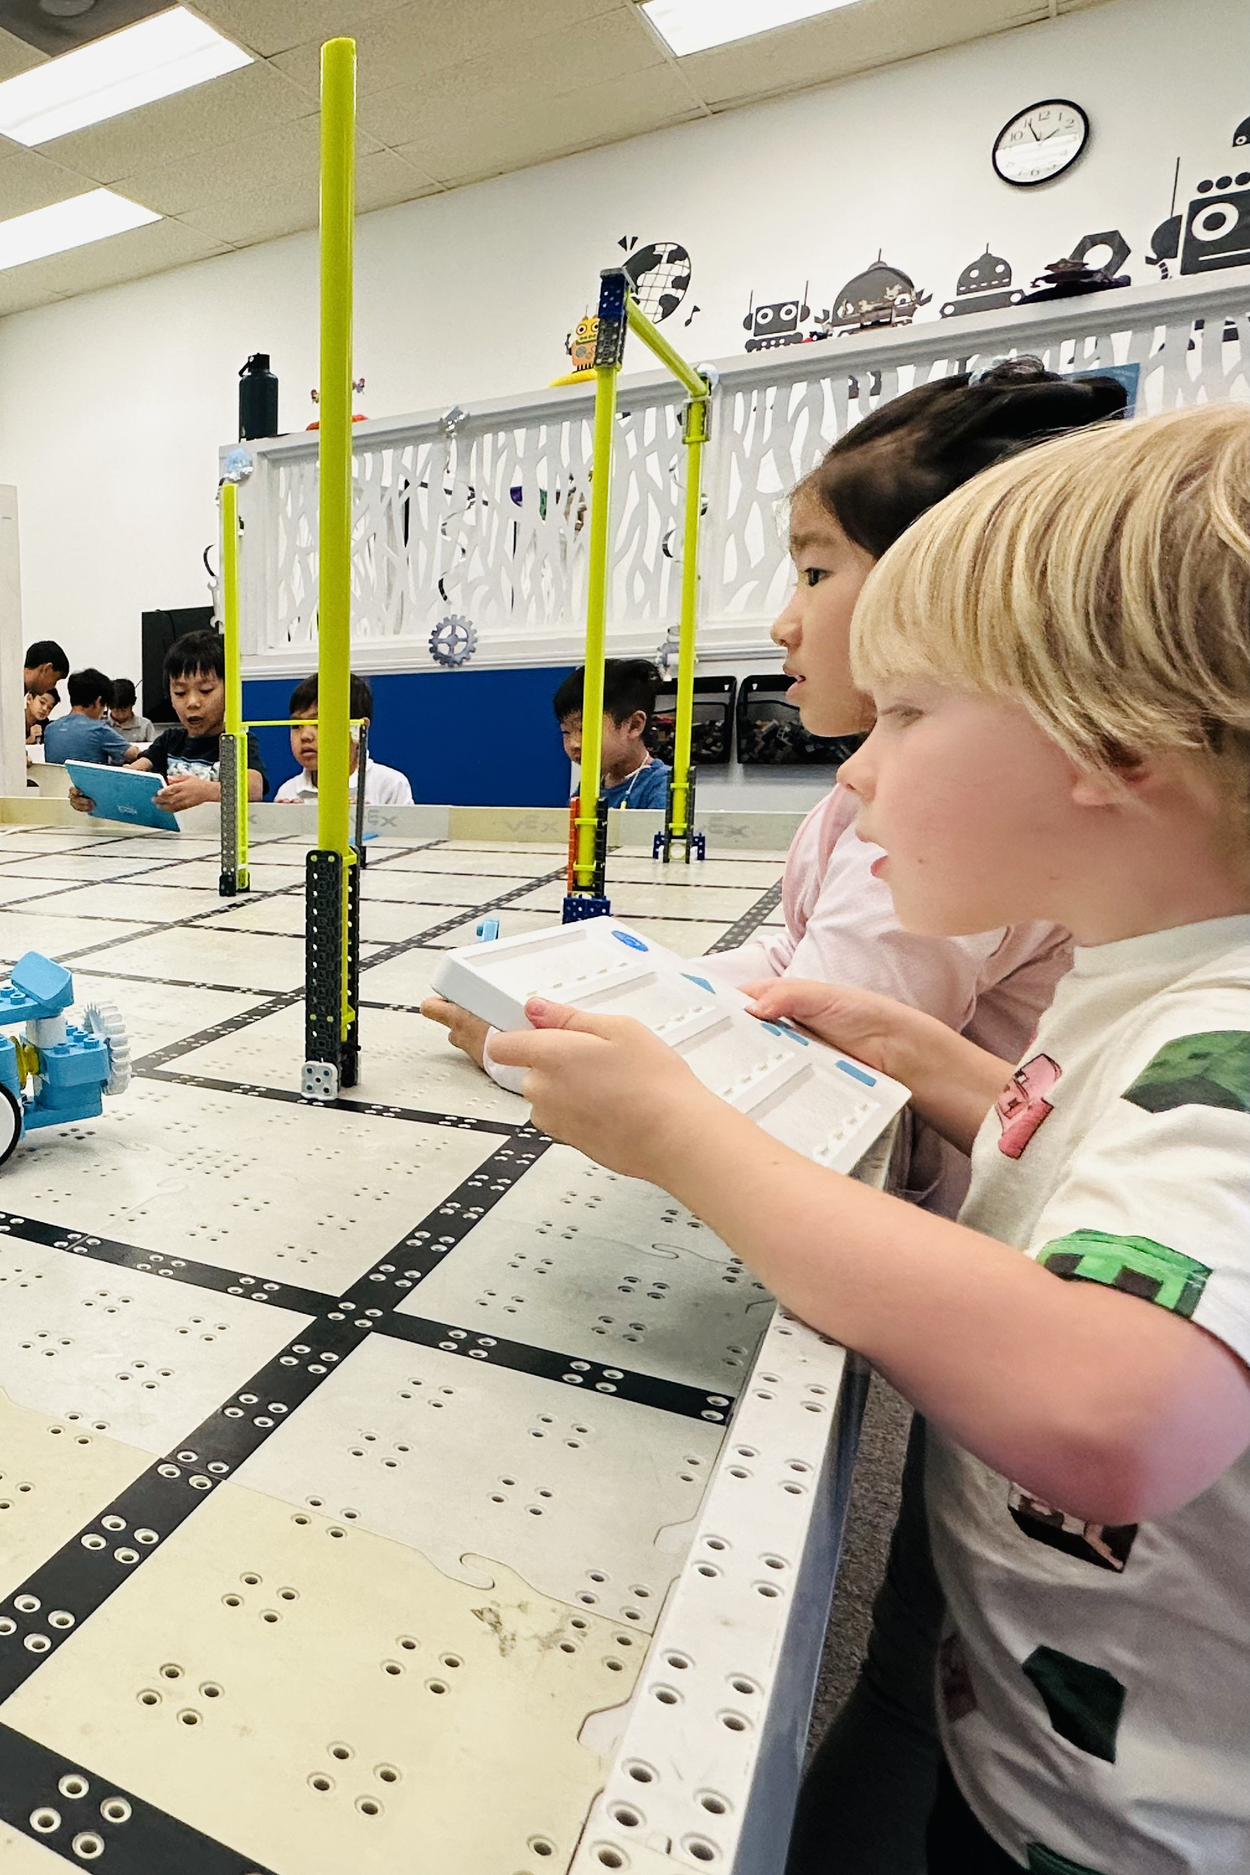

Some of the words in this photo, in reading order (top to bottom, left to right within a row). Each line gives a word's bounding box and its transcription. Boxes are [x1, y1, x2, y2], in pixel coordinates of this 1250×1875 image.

[1038, 110, 1050, 121] 12
[1065, 119, 1075, 129] 2
[1010, 131, 1024, 142] 10
